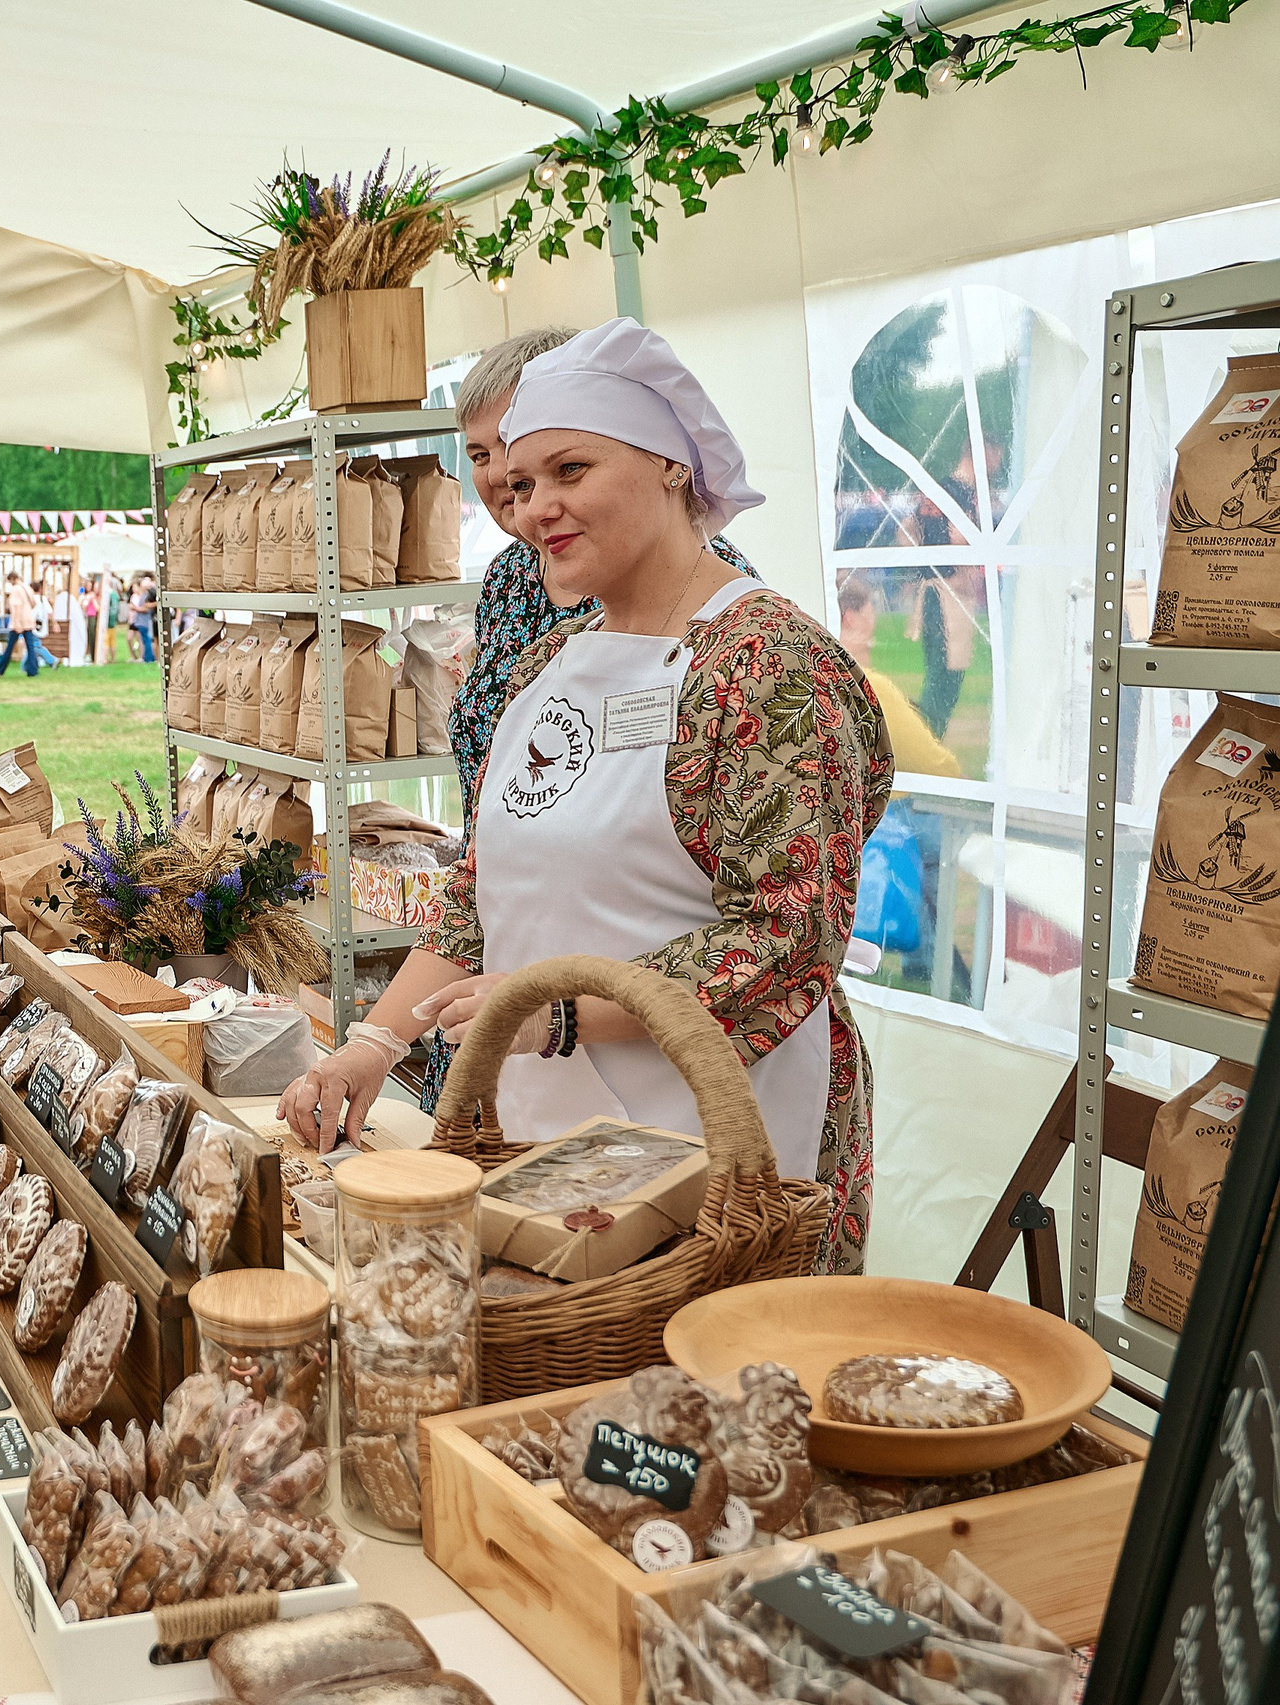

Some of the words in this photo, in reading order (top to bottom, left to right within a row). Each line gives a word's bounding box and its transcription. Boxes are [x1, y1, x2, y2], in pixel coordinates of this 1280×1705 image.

[1186, 536, 1276, 547] ЦЕЛЬНОЗЕРНОВАЯ
[1191, 548, 1232, 558] жернового
[1234, 548, 1265, 557] помола
[1207, 563, 1212, 571] 5
[1209, 573, 1223, 582] 2,05
[533, 709, 584, 773] ЛОВСКИЙ
[1224, 790, 1261, 806] МУКА
[1166, 886, 1244, 917] ЦЕЛЬНОЗЕРНОВАЯ
[1168, 900, 1206, 917] жернового
[1206, 907, 1234, 924] помола
[1182, 917, 1188, 925] 5
[1183, 927, 1196, 938] 2,05
[597, 1424, 697, 1478] Петушок
[626, 1467, 670, 1492] 150
[821, 1592, 874, 1625] 100
